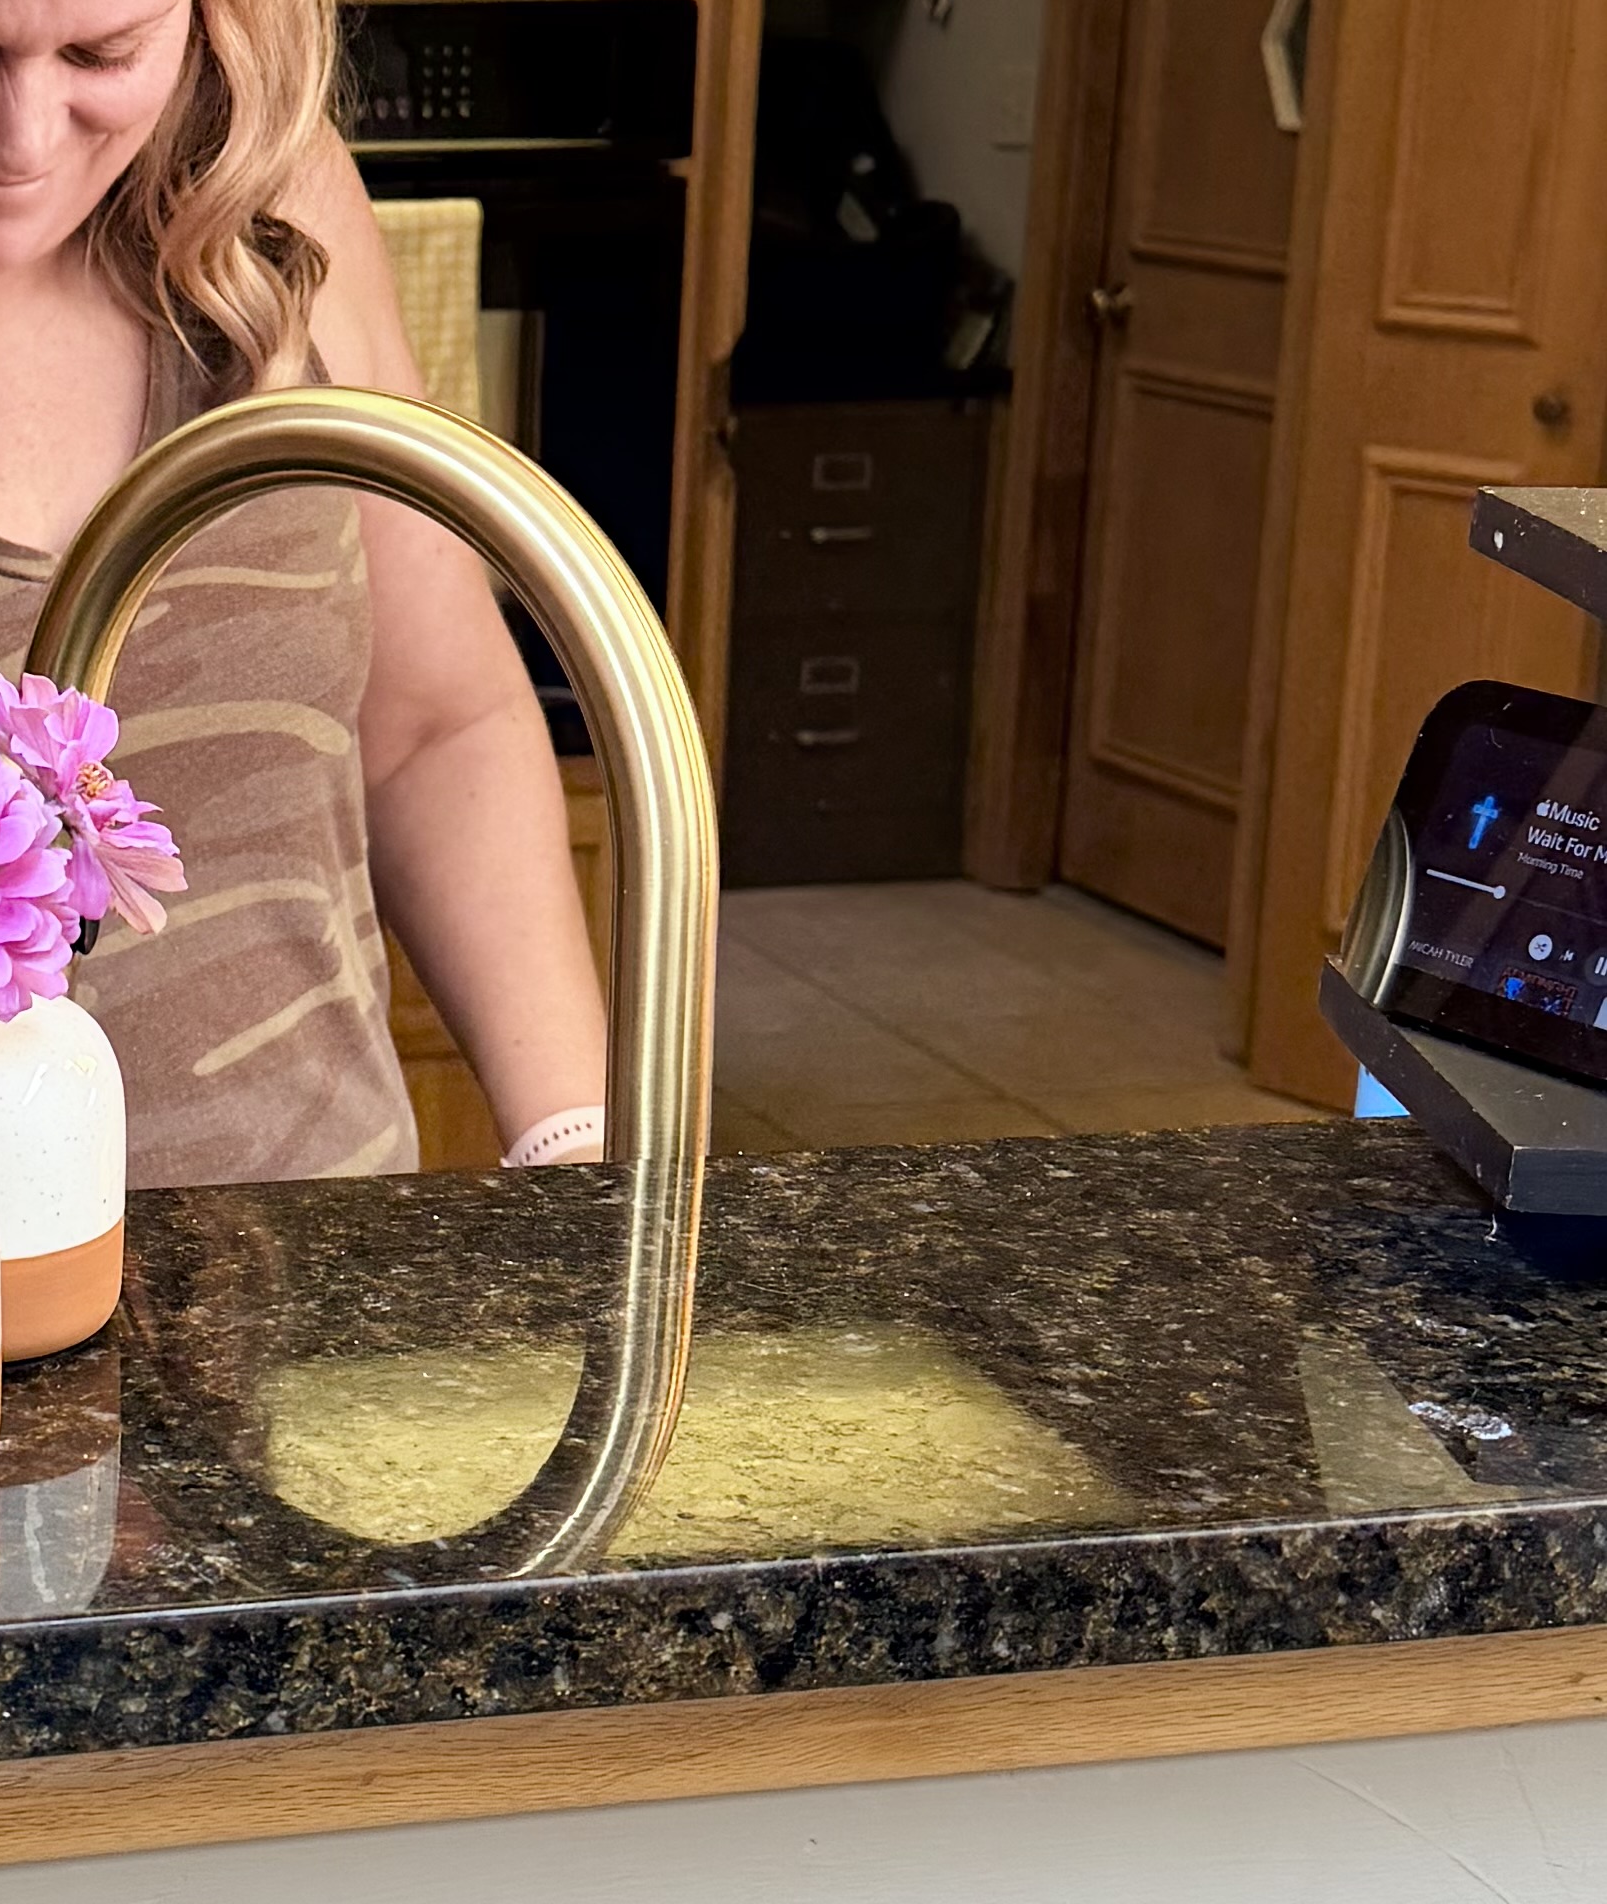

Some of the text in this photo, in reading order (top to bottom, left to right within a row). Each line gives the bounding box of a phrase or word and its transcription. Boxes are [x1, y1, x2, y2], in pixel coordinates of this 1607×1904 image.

[1549, 801, 1600, 831] Music
[1527, 825, 1565, 851] Wait
[1564, 837, 1593, 858] For
[1559, 863, 1584, 879] Time
[1407, 940, 1475, 969] MICAH TYLER
